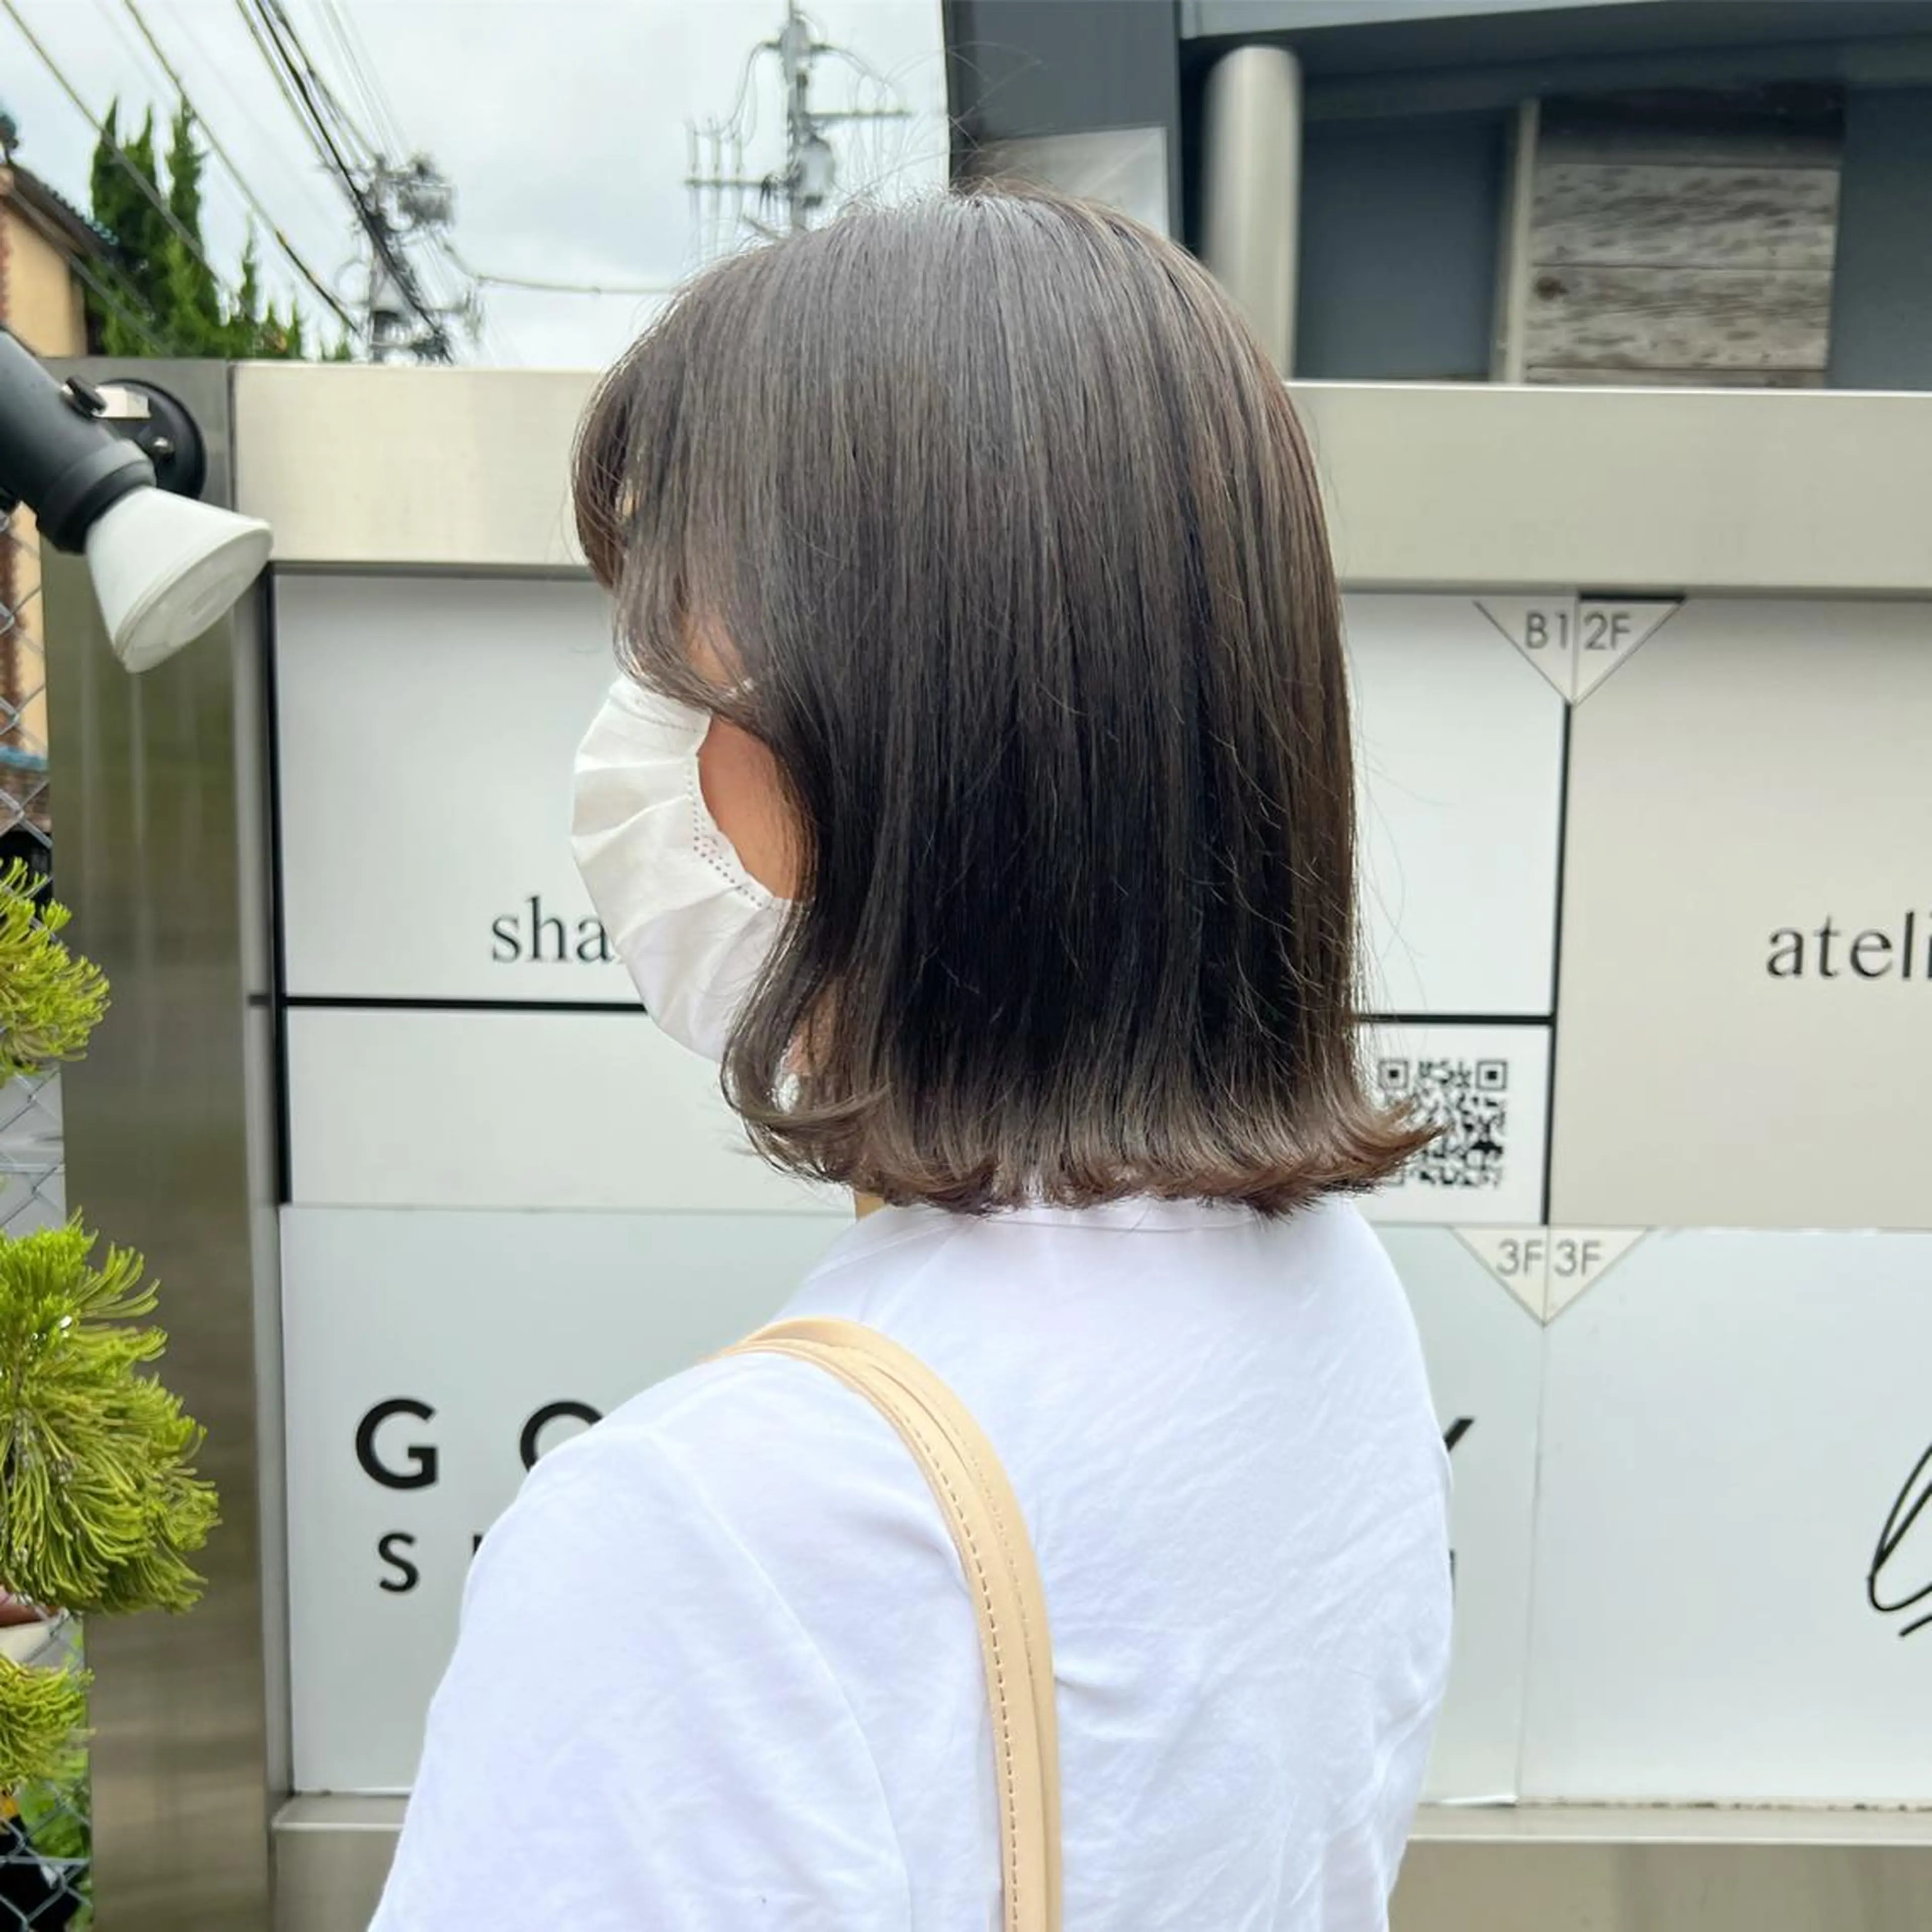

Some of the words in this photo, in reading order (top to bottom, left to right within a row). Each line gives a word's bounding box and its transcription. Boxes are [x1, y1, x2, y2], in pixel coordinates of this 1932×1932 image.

[1525, 611, 1568, 650] B1
[1583, 611, 1632, 651] 2F
[492, 896, 624, 962] sha
[1496, 1238, 1543, 1277] 3F
[1554, 1238, 1602, 1277] 3F
